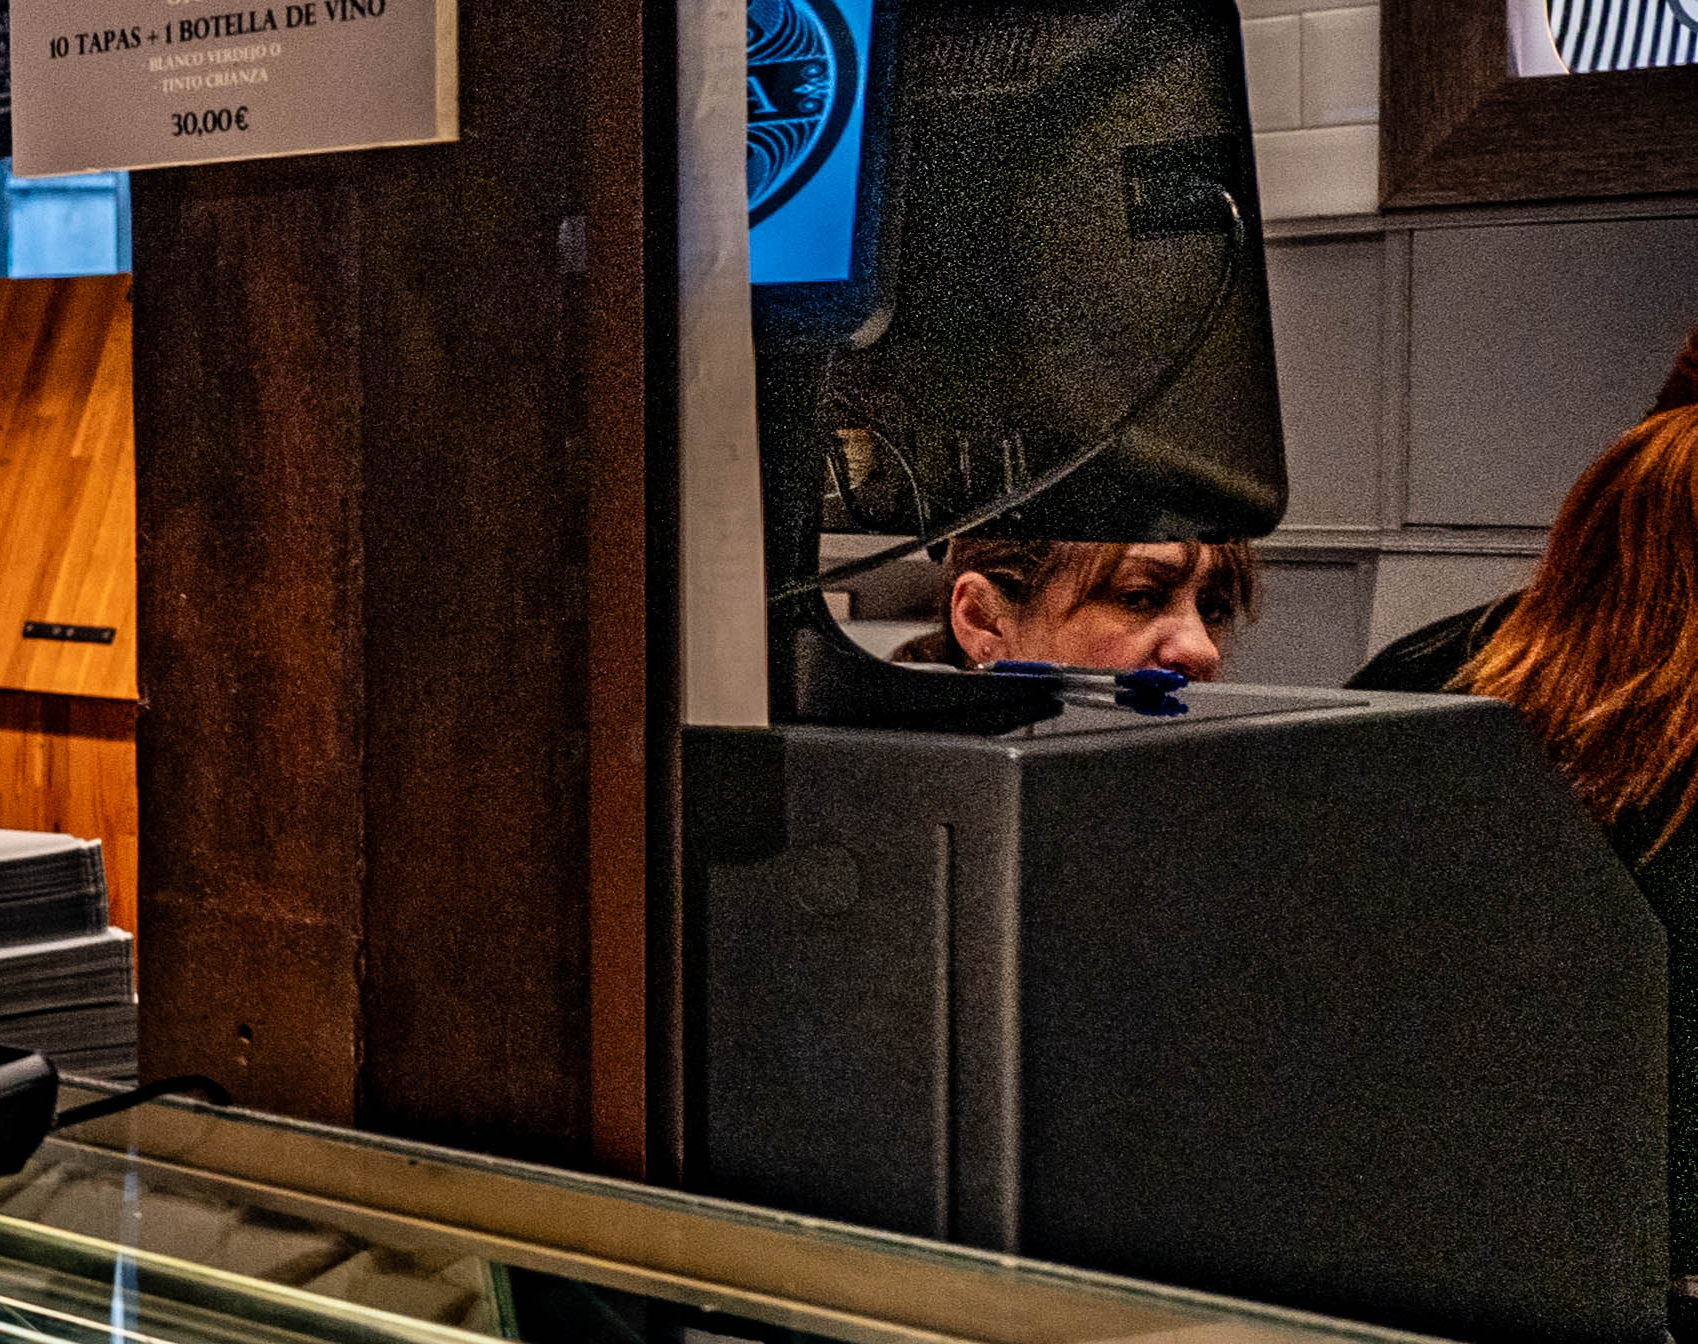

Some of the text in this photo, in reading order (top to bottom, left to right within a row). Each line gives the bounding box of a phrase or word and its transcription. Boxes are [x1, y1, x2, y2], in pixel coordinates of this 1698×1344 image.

[49, 37, 69, 60] 10
[75, 26, 141, 57] TAPAS
[147, 30, 159, 46] +
[165, 23, 173, 44] 1
[179, 8, 277, 43] BOTELLA
[286, 2, 317, 29] DE
[149, 51, 201, 73] BLANCO
[206, 45, 267, 65] VERDEJO
[161, 67, 269, 94] TINTO CRIANZA
